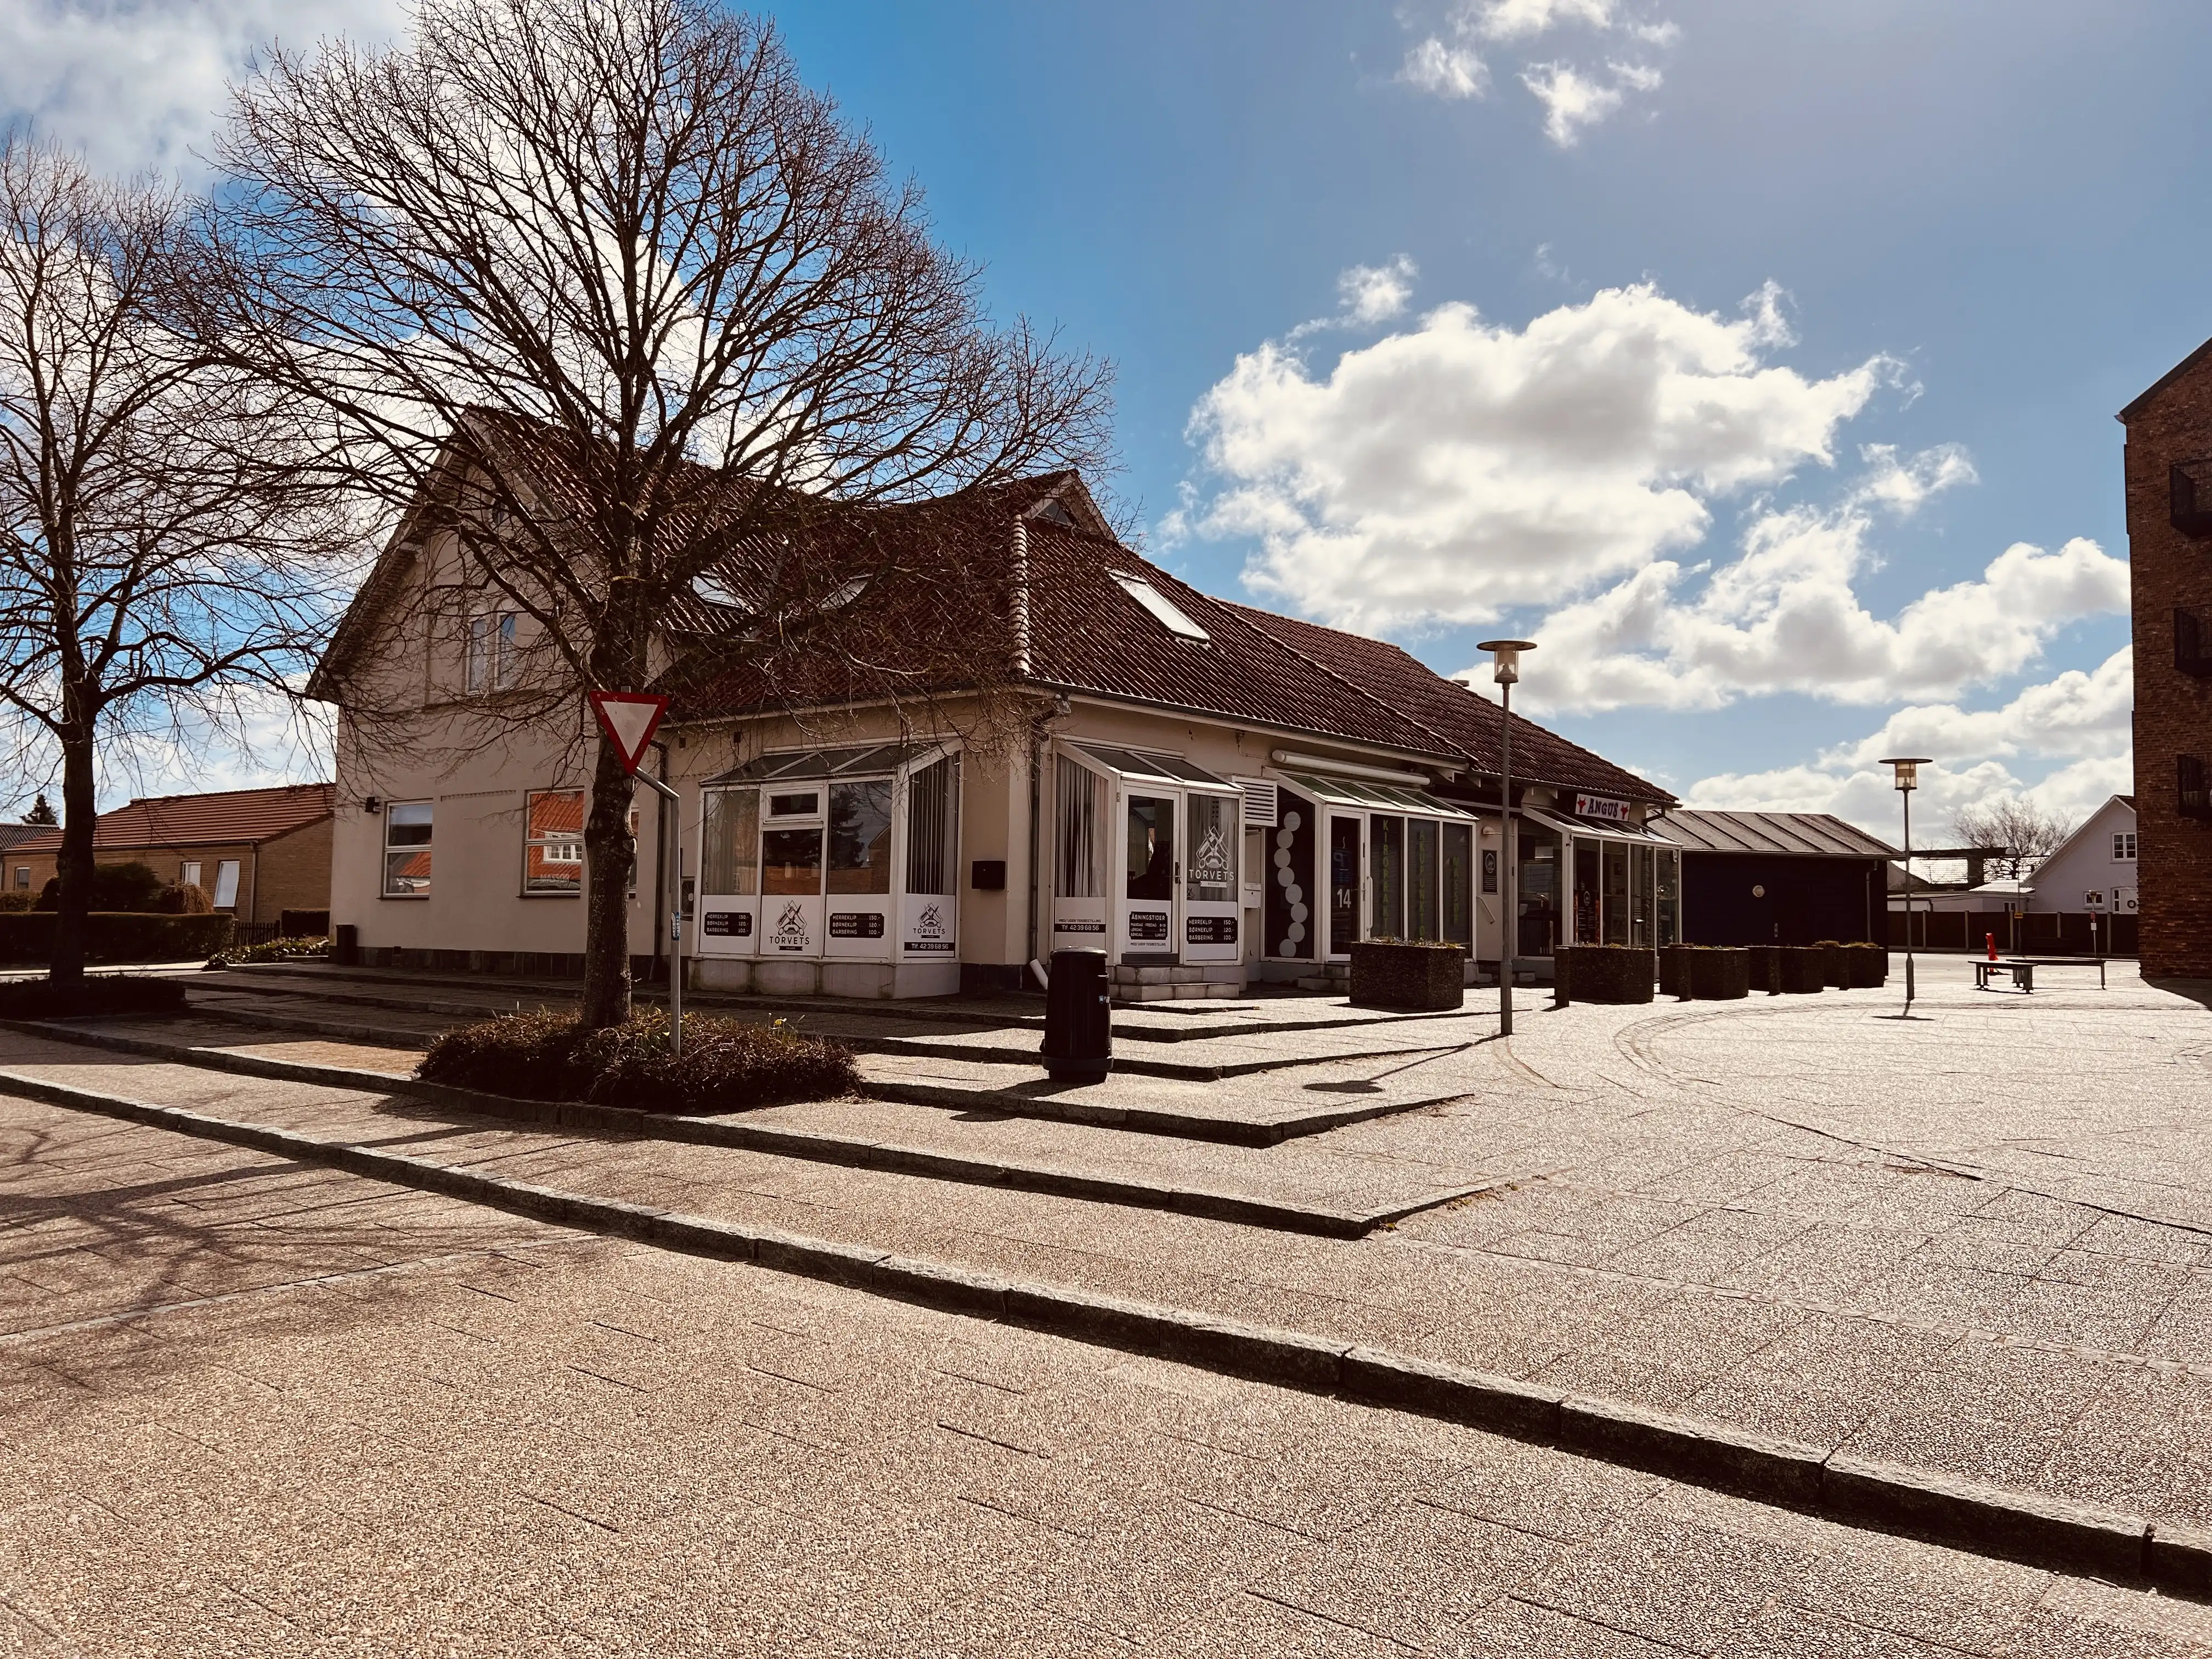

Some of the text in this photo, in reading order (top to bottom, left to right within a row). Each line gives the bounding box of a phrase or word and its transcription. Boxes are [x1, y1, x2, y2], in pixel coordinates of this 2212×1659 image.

[1588, 798, 1618, 819] ANGUS
[1189, 869, 1234, 881] TORVETS
[1337, 888, 1351, 908] 14
[769, 936, 810, 945] TORVETS
